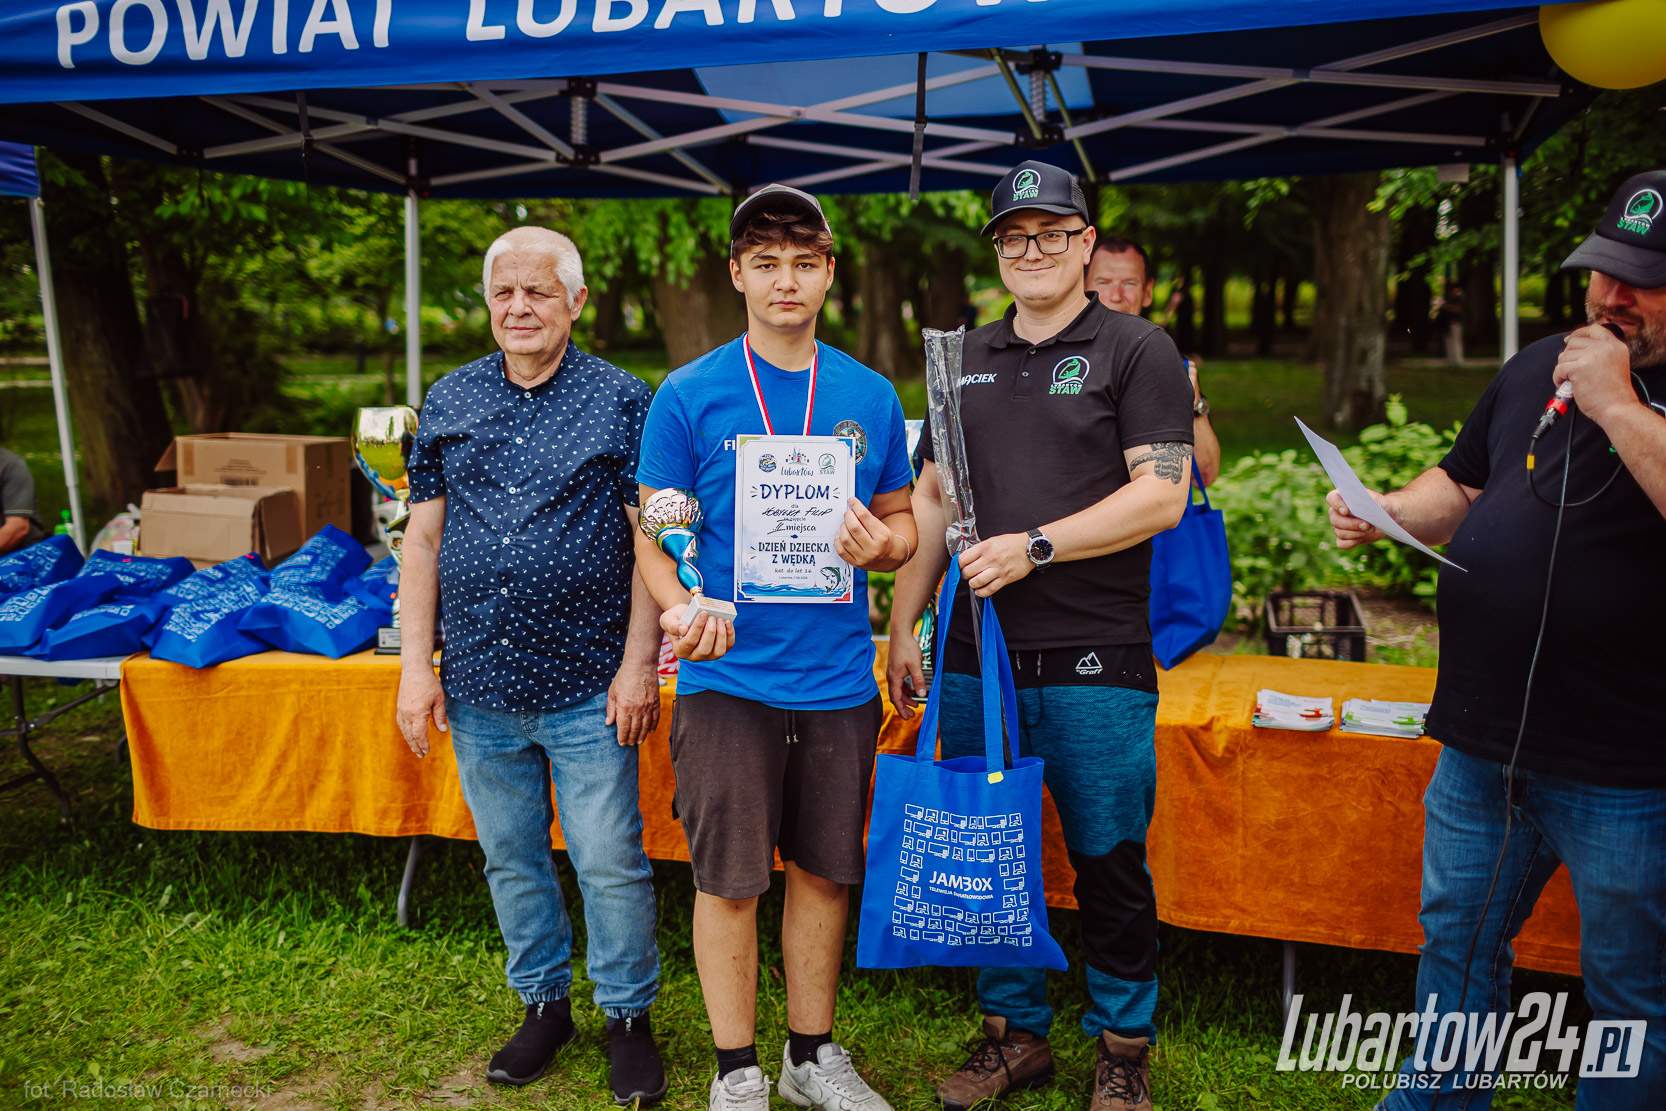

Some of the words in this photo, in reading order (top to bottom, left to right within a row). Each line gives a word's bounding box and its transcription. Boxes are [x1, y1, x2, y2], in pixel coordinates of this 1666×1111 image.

[56, 0, 391, 68] POWIAT
[1048, 385, 1082, 395] STAW
[760, 484, 829, 500] DYPLOM
[786, 523, 816, 533] miejsca
[758, 540, 786, 552] DZIEŃ
[789, 542, 830, 553] DZIECKA
[772, 554, 778, 564] Z
[781, 554, 816, 566] WĘDKĄ
